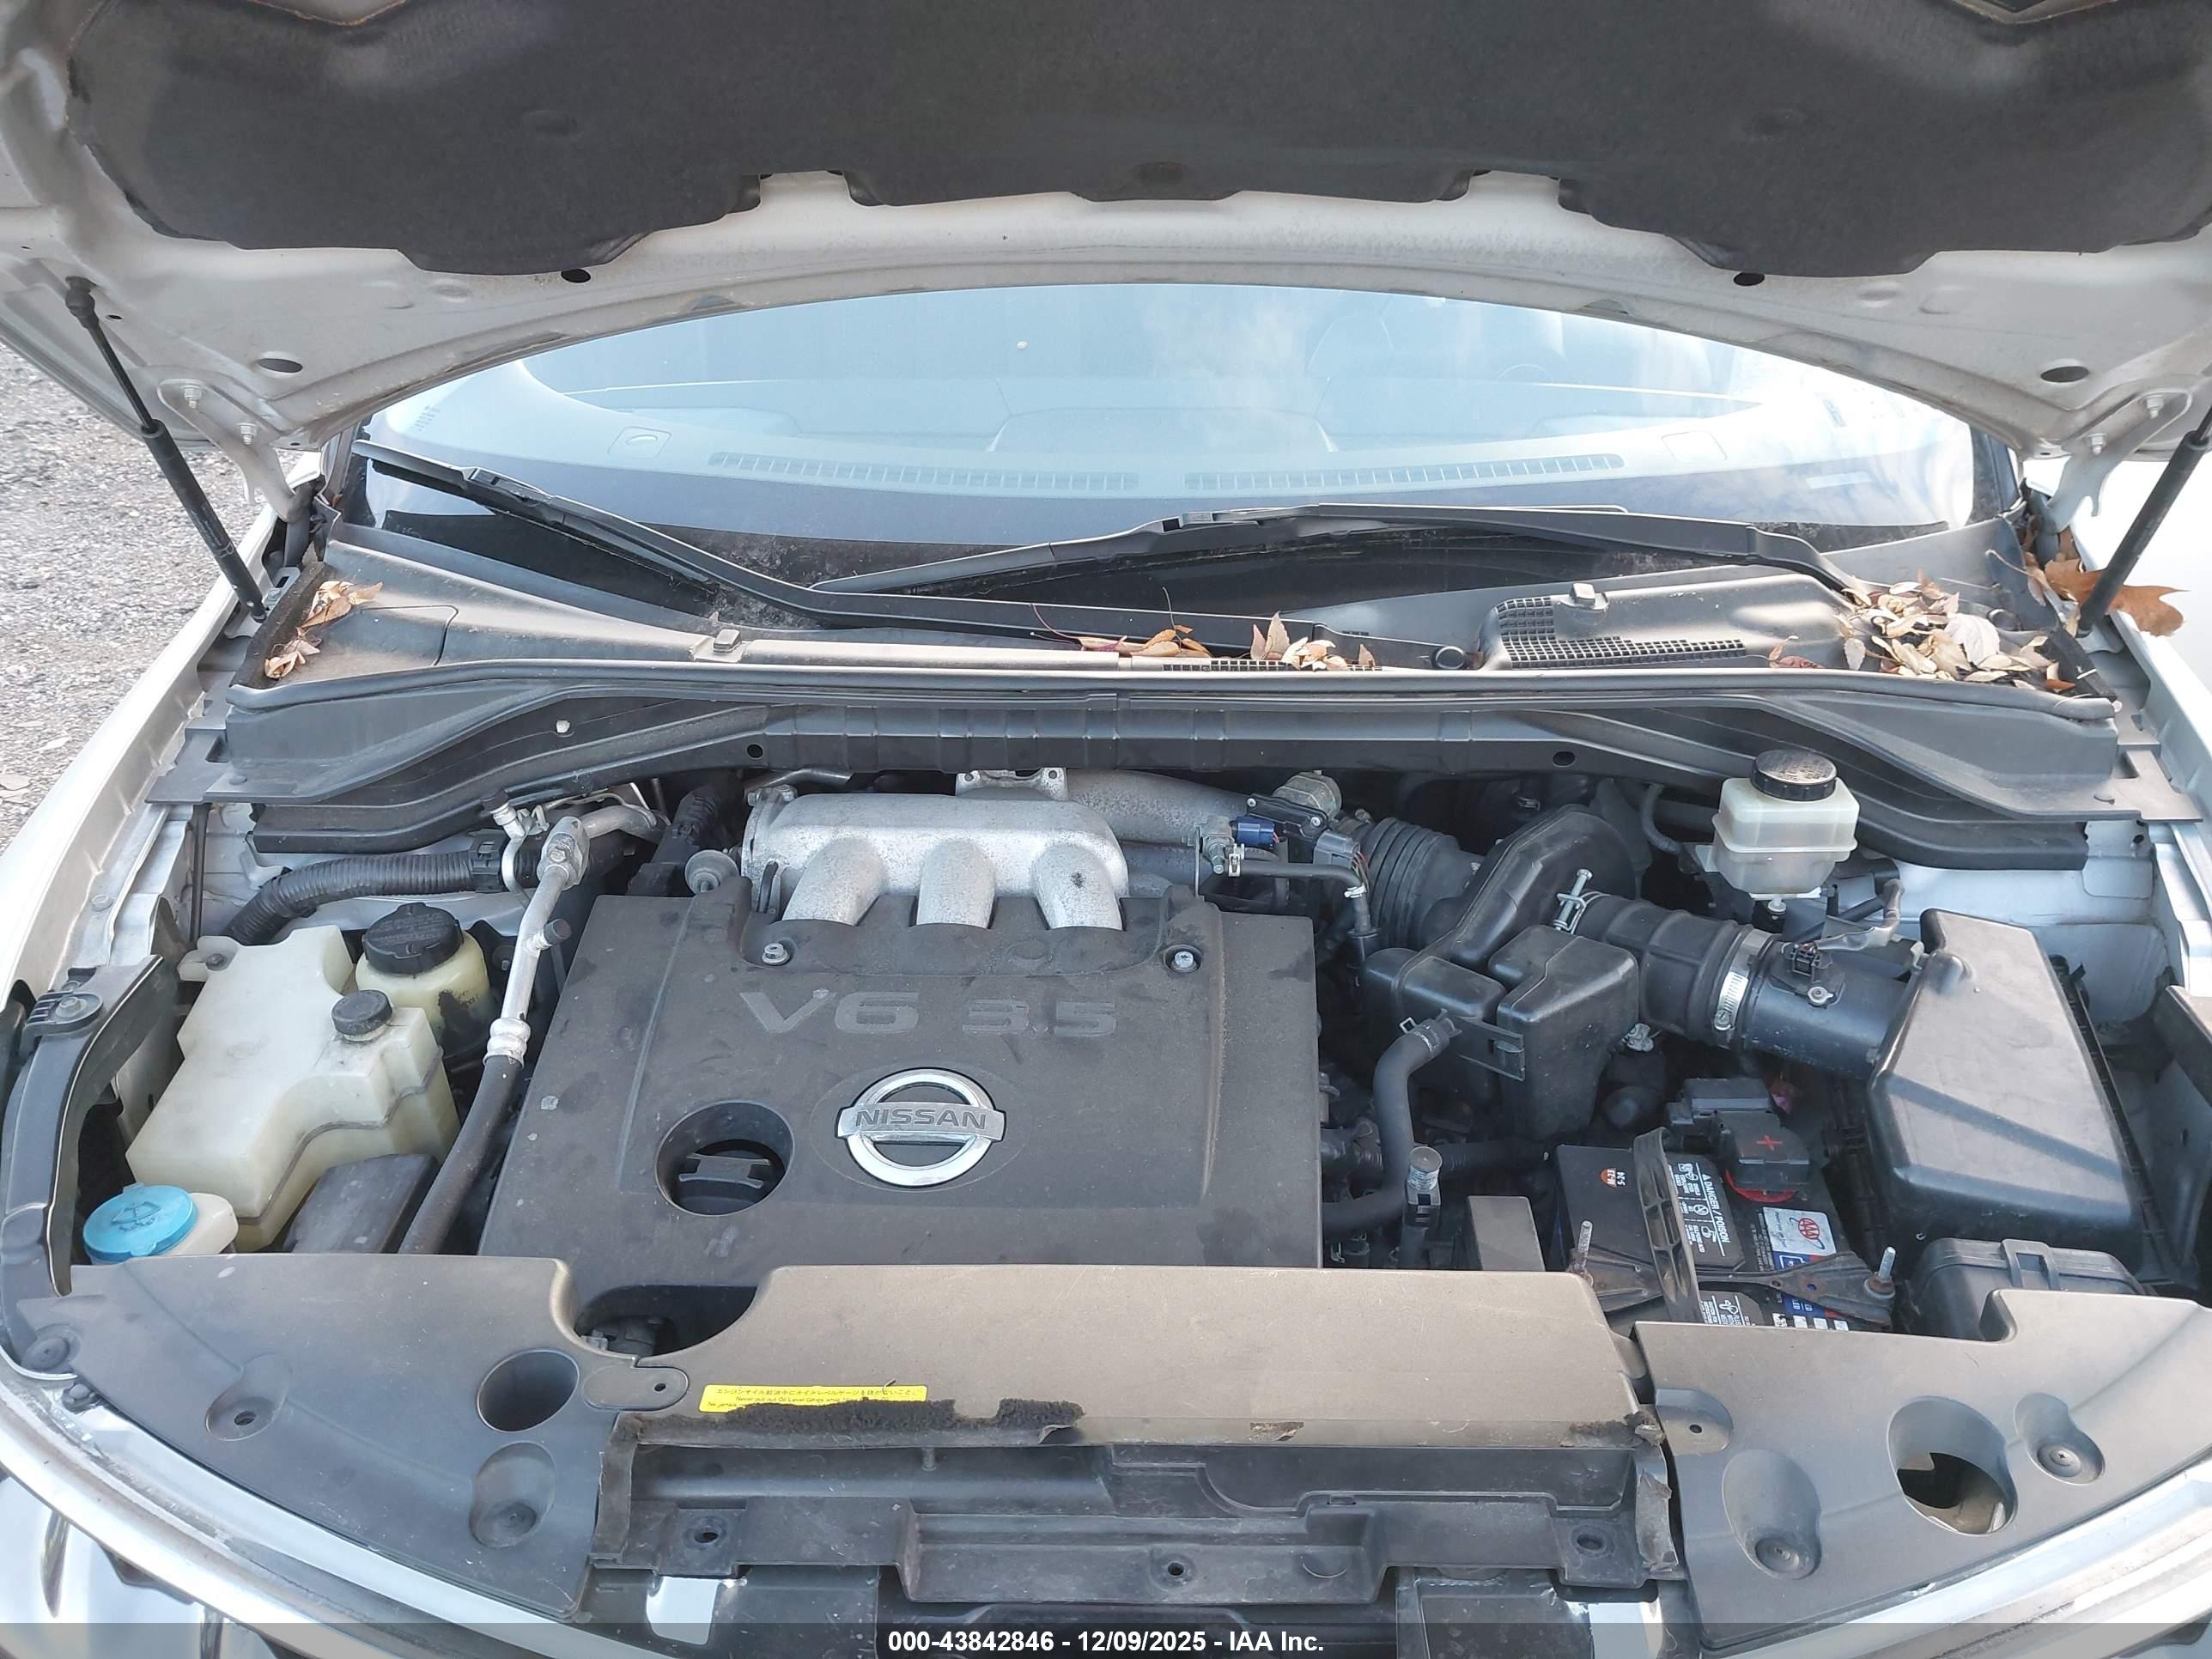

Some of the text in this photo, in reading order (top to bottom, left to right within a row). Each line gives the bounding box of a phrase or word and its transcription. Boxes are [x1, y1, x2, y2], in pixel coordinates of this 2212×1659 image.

[739, 991, 1118, 1037] V6 3.5
[854, 1106, 988, 1131] NISSAN
[1704, 1181, 1720, 1210] DANGER
[1714, 1215, 1731, 1243] POISON
